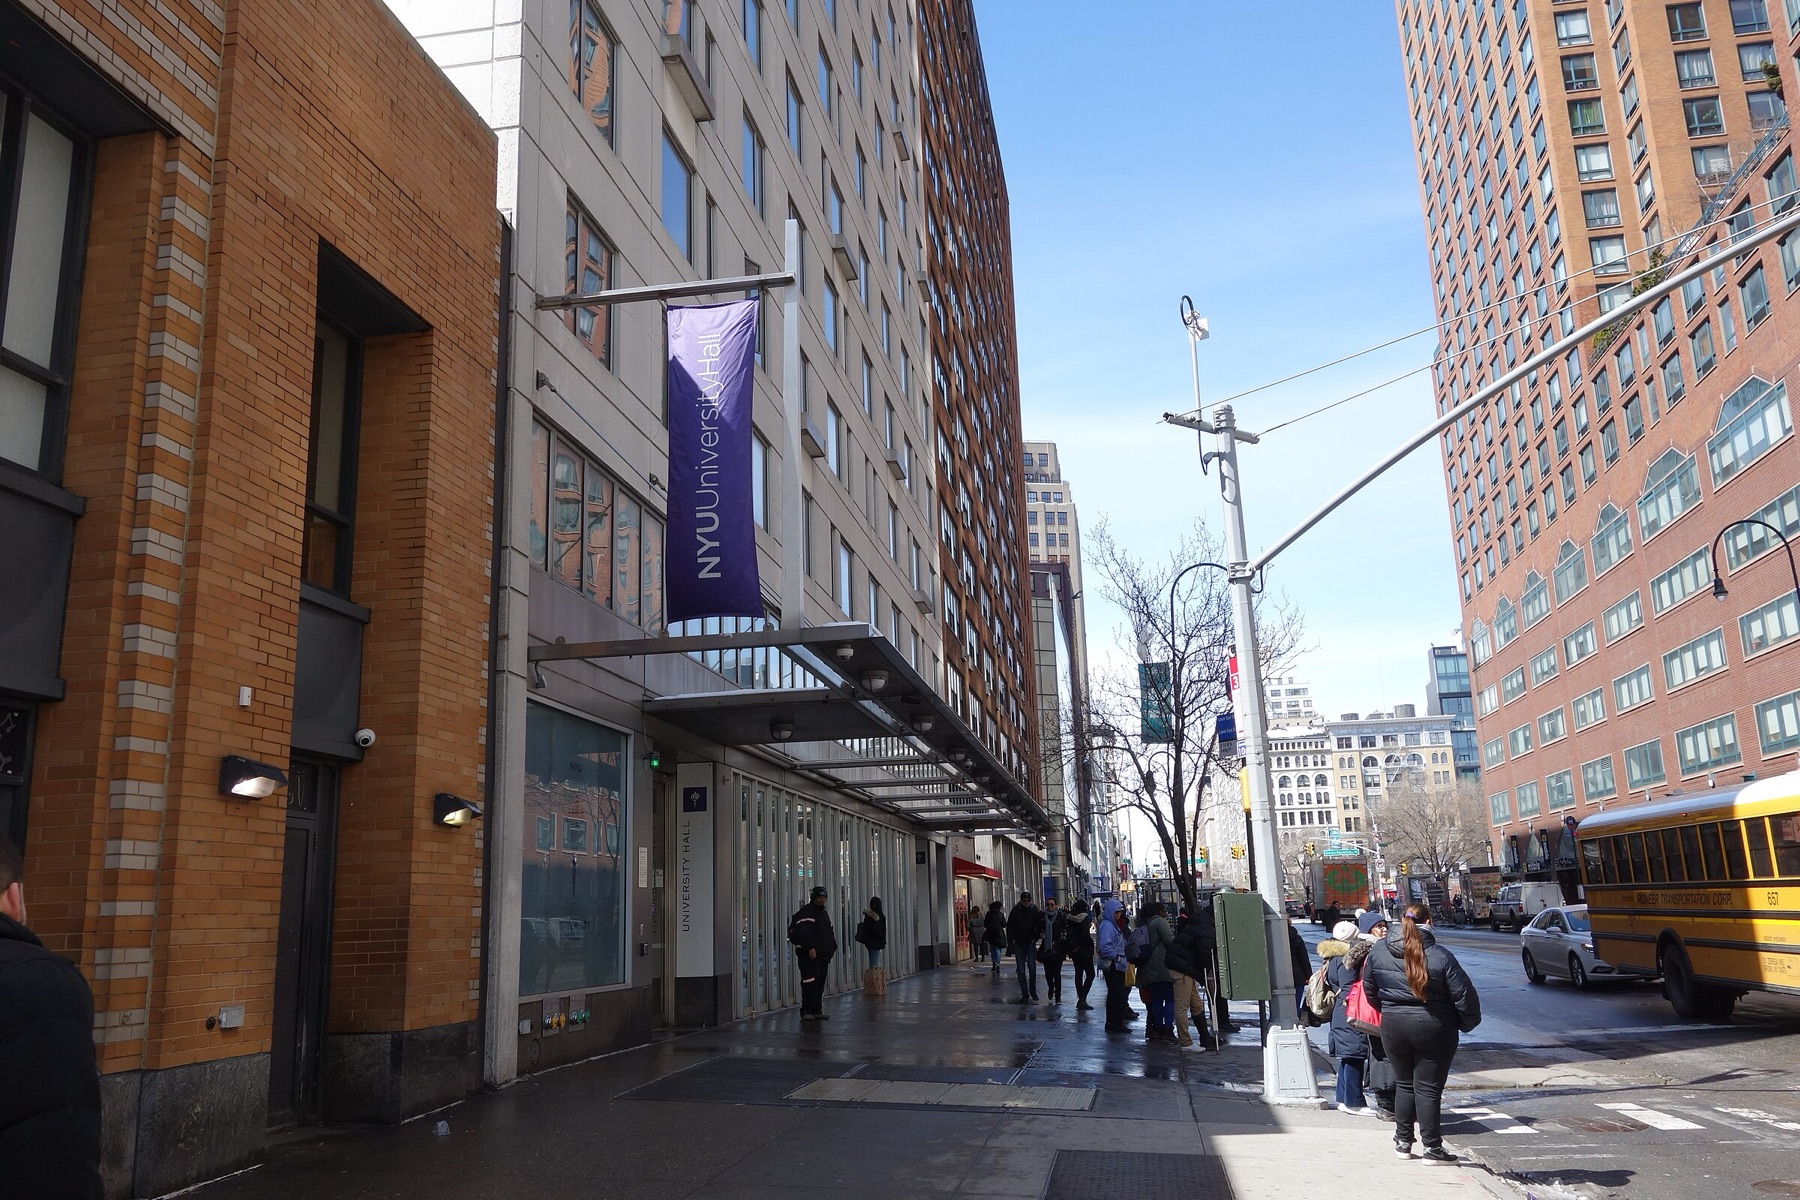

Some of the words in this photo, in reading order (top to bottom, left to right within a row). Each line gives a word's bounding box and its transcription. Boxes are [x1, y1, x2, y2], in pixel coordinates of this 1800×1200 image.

[682, 821, 690, 853] HALL
[682, 857, 690, 932] UNIVERSITY
[1660, 892, 1711, 906] TRANSPORTATION
[1767, 891, 1779, 906] 657
